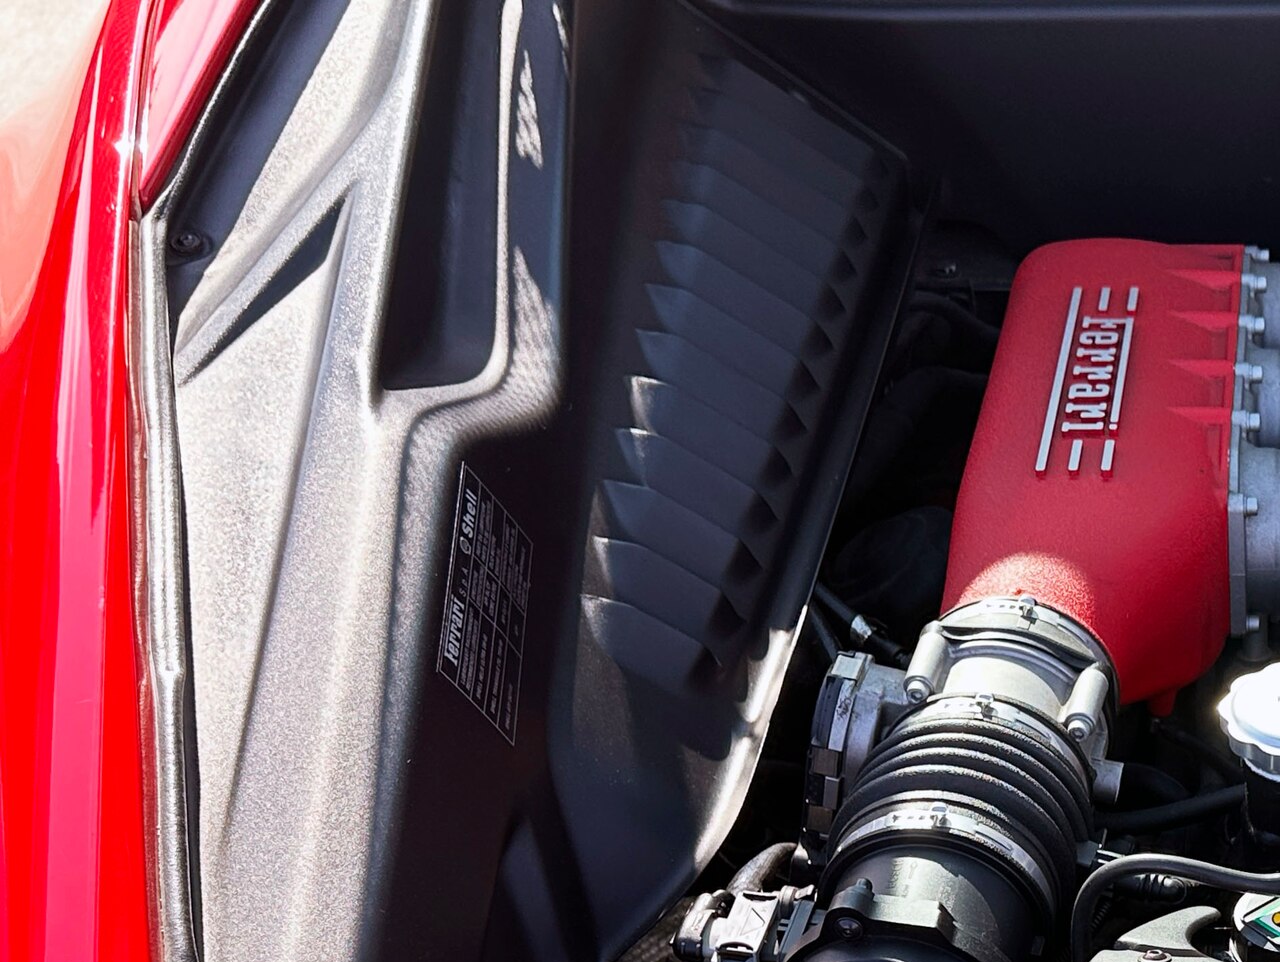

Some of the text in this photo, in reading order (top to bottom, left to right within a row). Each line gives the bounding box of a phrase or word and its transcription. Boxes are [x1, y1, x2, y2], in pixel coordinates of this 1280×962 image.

[1061, 316, 1134, 432] Ferrari
[461, 488, 477, 538] Shell
[444, 594, 465, 667] Ferrari
